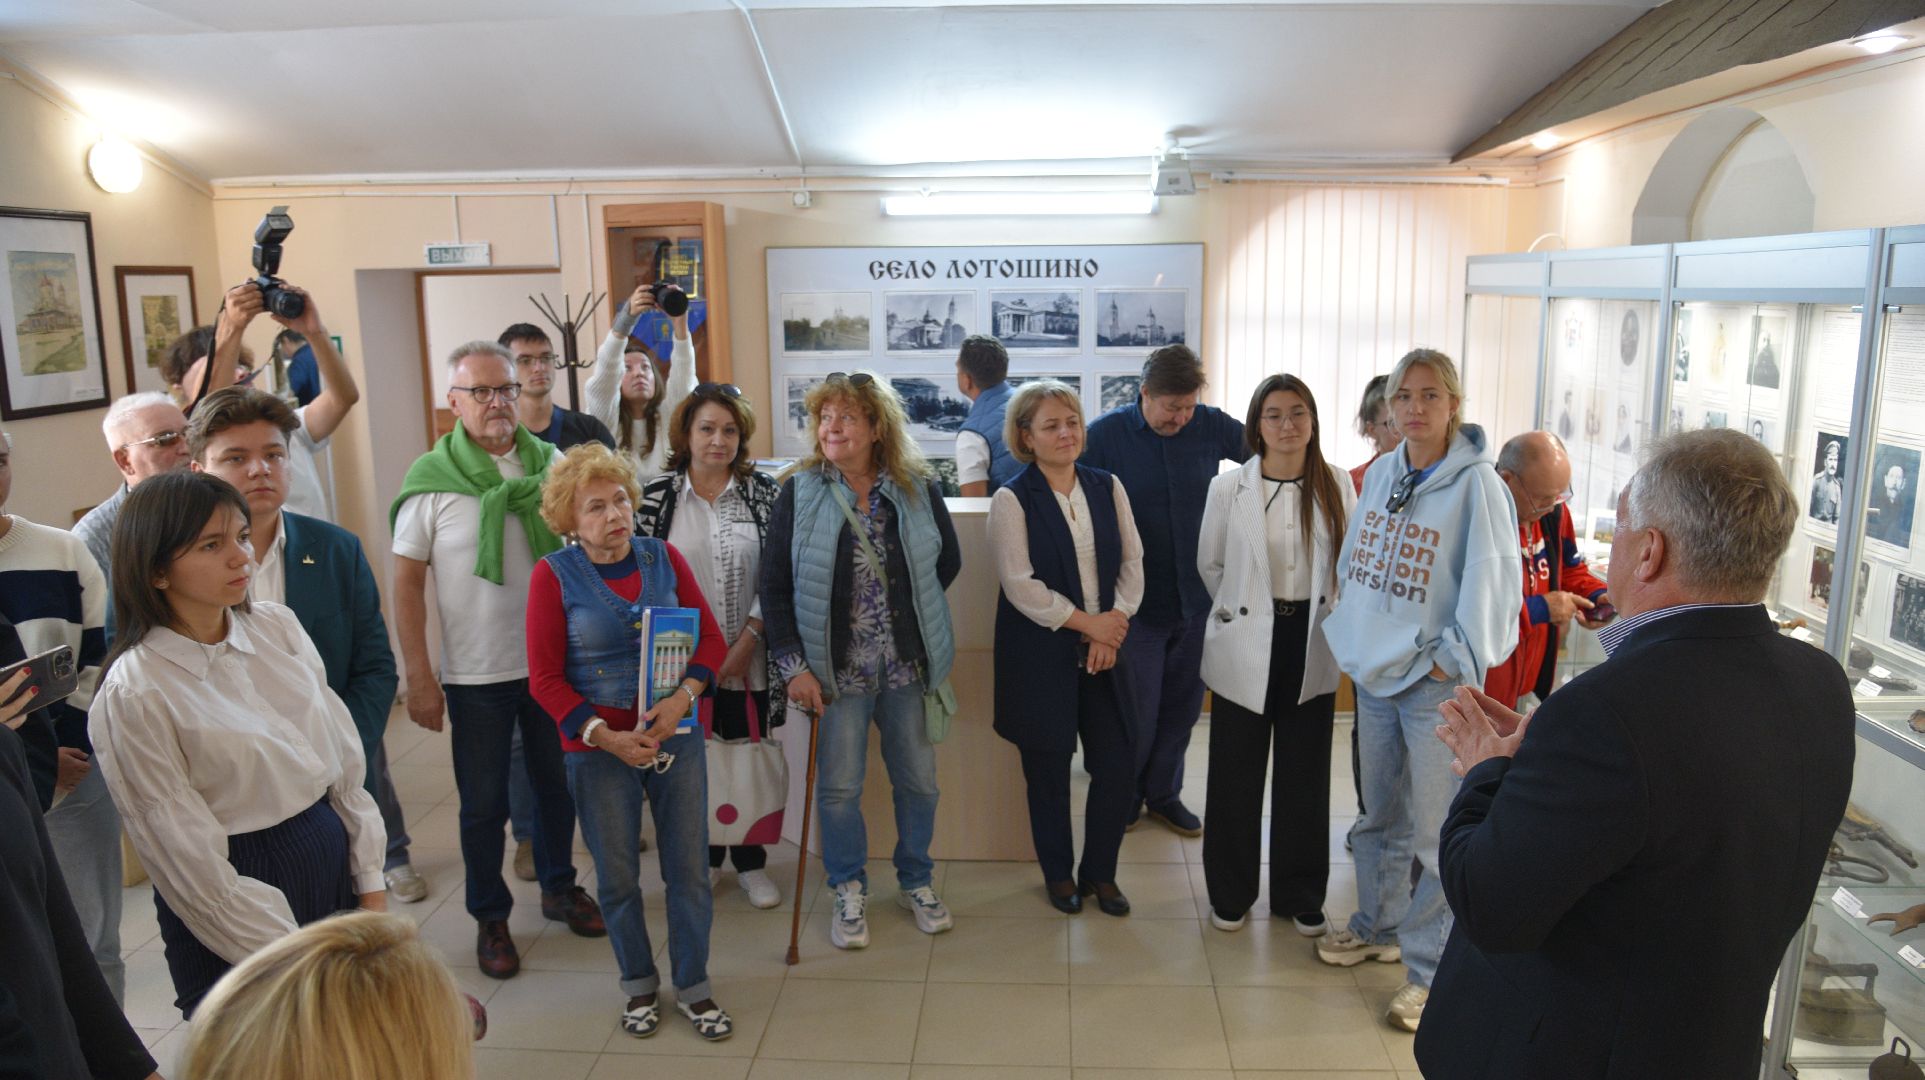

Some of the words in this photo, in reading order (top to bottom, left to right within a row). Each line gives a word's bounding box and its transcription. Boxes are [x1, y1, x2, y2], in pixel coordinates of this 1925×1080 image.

[869, 259, 936, 280] СЕЛО
[947, 258, 1099, 279] ЛОТОШИНО
[1364, 510, 1441, 547] ersion
[1347, 564, 1427, 604] version
